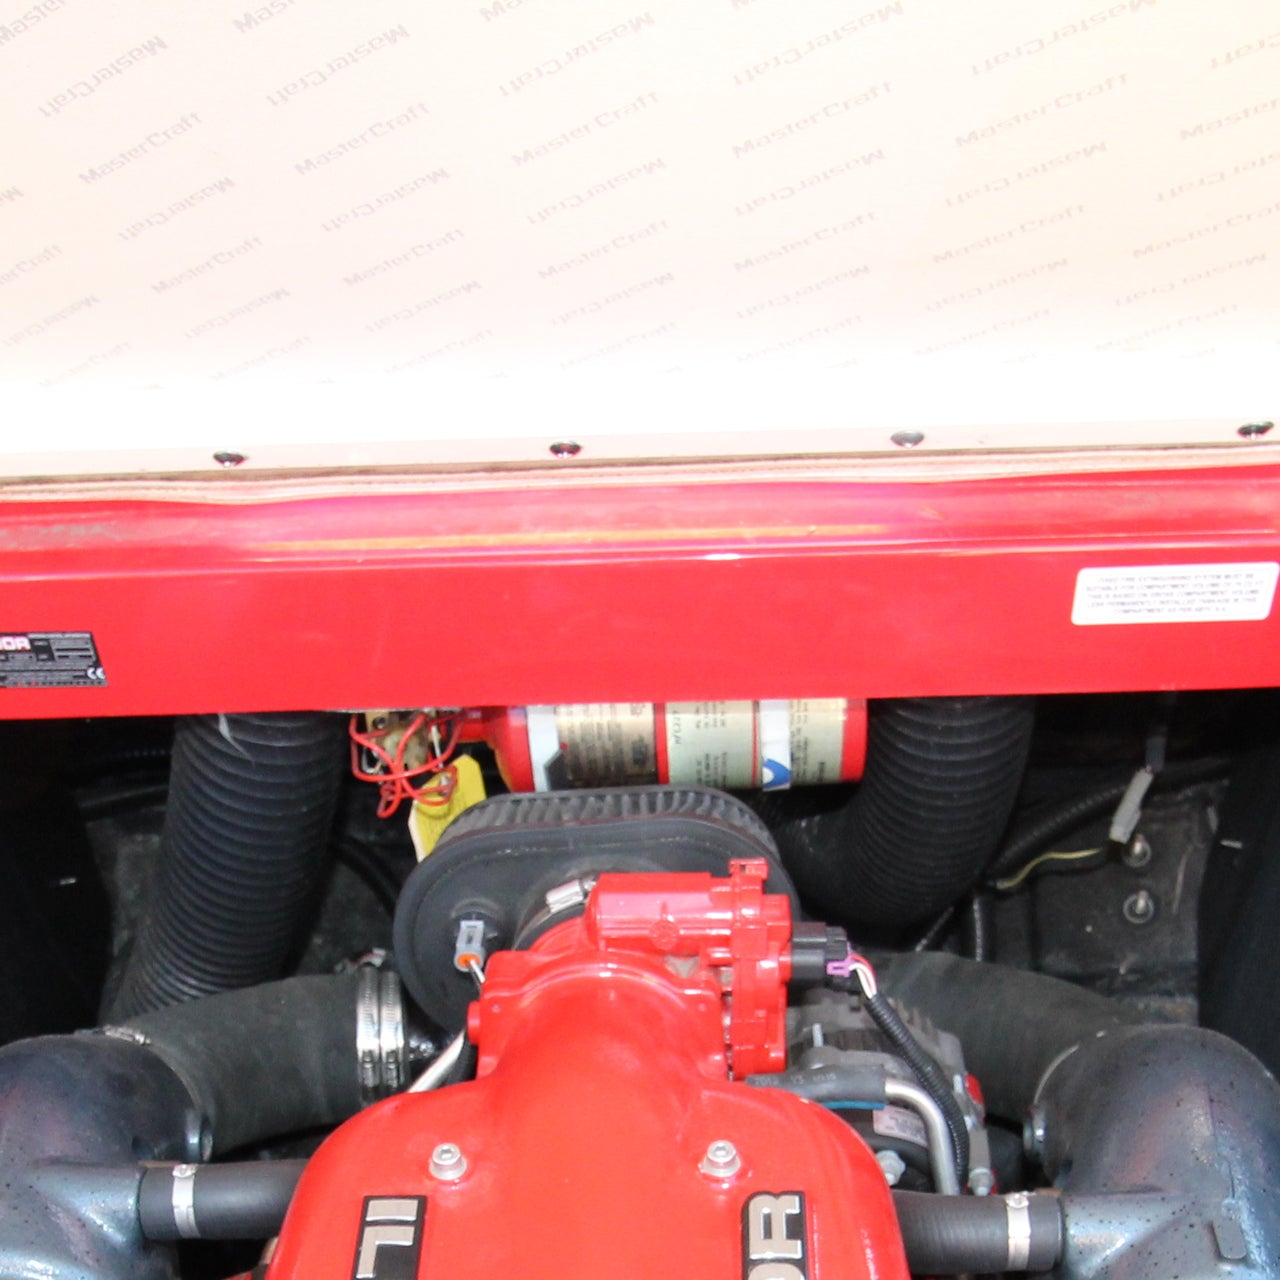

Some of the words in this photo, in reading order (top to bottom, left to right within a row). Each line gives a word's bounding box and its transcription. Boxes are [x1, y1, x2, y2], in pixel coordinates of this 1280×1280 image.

[37, 35, 170, 118] MasterCraft
[265, 24, 411, 107] MasterCraft
[498, 11, 655, 97] MasterCraft
[733, 1, 904, 85] MasterCraft
[294, 101, 430, 176] MasterCraft
[511, 91, 658, 166] MasterCraft
[731, 81, 891, 159] MasterCraft
[954, 73, 1127, 148] MasterCraft
[78, 112, 203, 185] MasterCraft
[734, 148, 886, 217] MasterCraft
[945, 140, 1107, 208] MasterCraft
[118, 176, 236, 240] MasterCraft
[320, 167, 451, 232] MasterCraft
[526, 157, 667, 225] MasterCraft
[341, 228, 465, 287] MasterCraft
[537, 219, 669, 280] MasterCraft
[732, 211, 875, 273] MasterCraft
[929, 204, 1085, 264] MasterCraft
